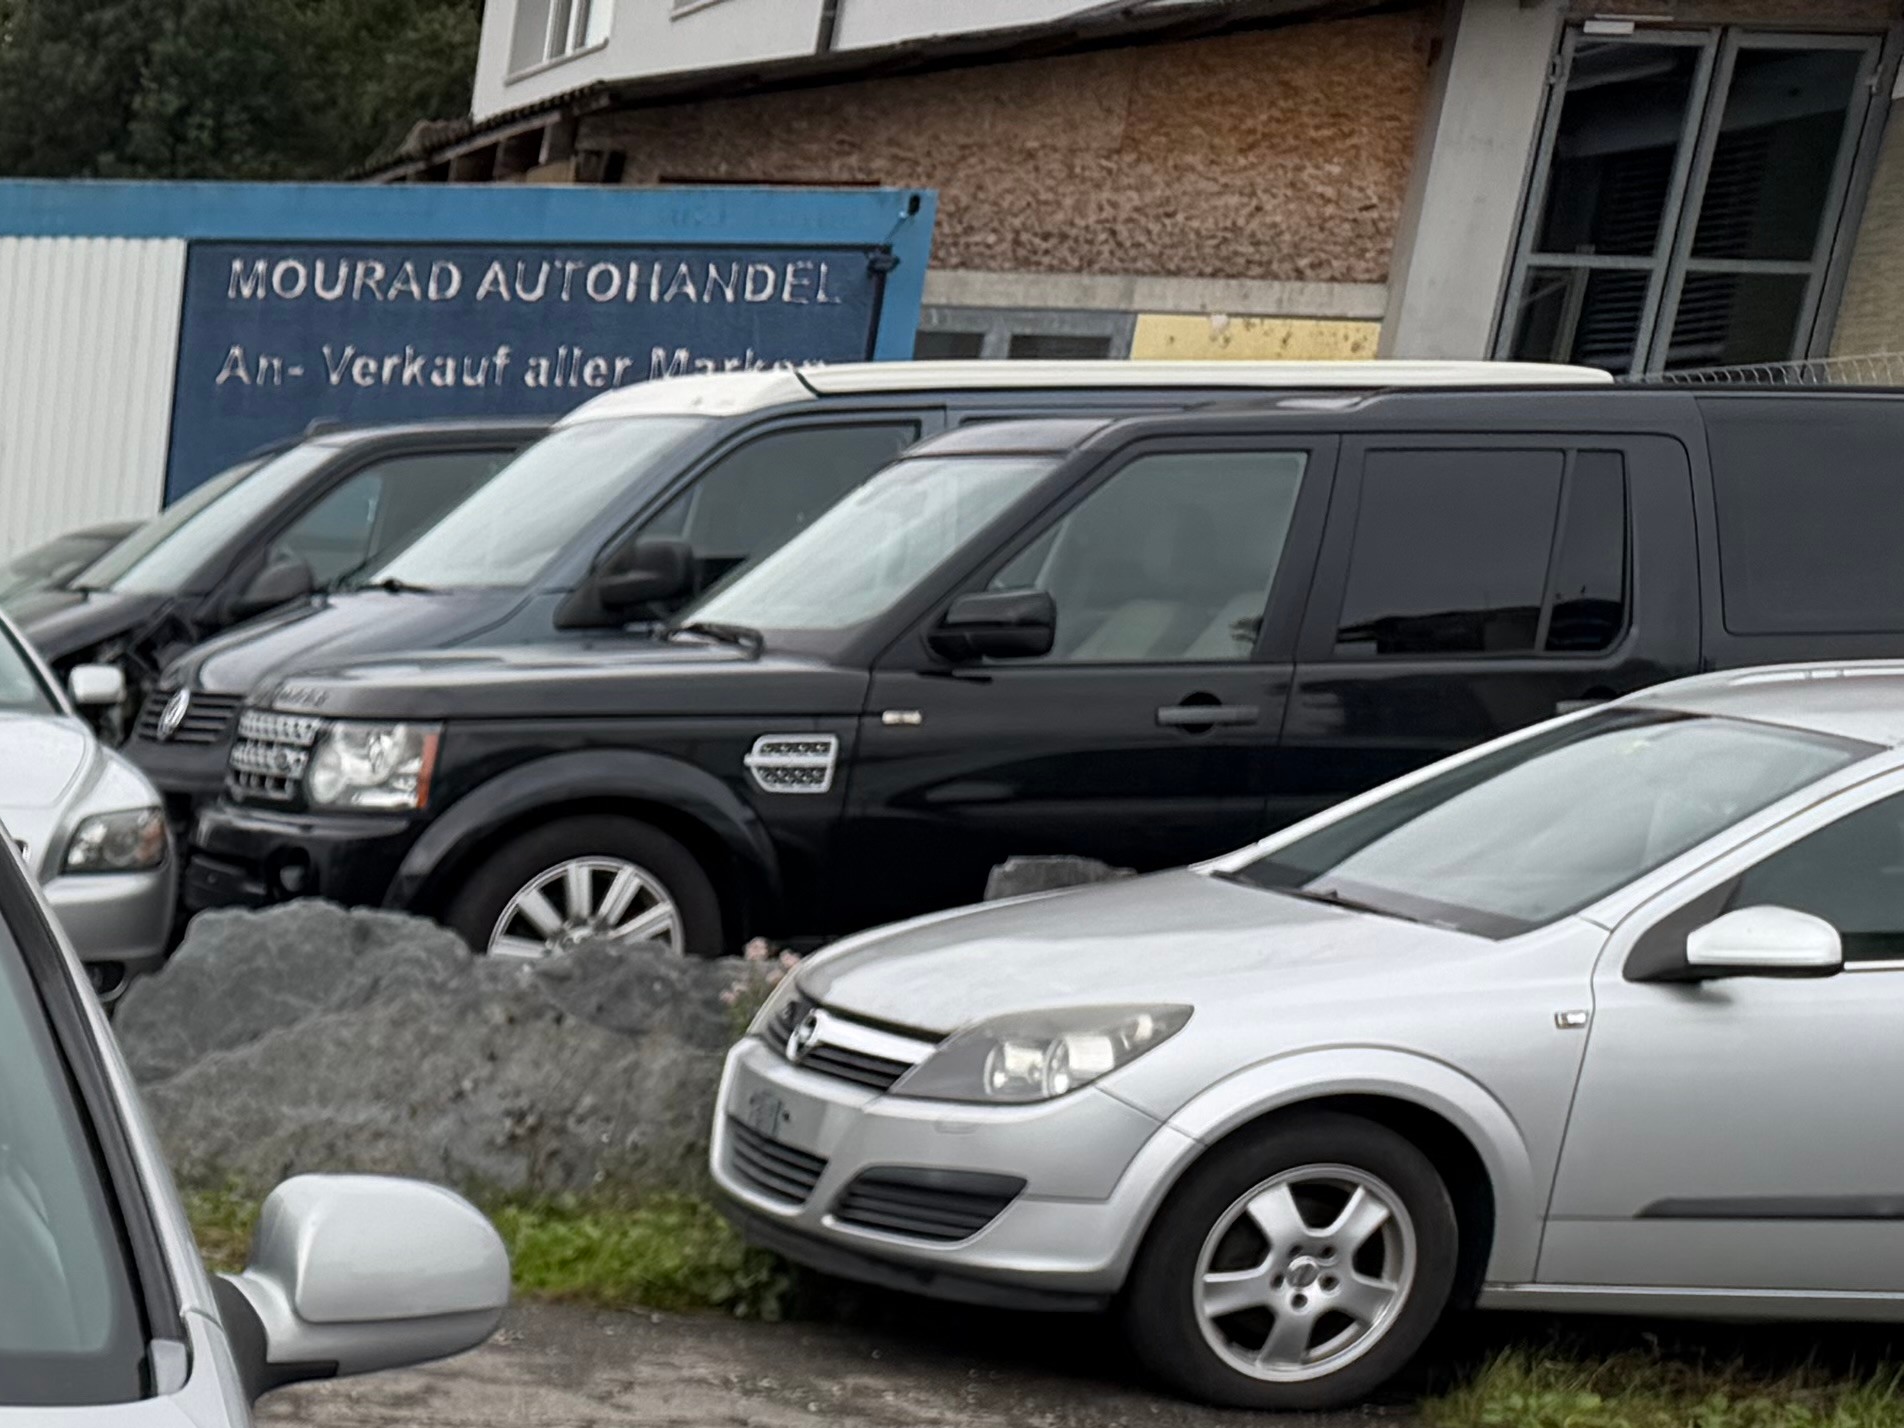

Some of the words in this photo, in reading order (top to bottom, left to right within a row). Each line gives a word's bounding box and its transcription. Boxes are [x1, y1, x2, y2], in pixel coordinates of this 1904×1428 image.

[228, 258, 462, 300] MOURAD
[476, 260, 841, 303] AUTOHANDEL
[215, 345, 304, 387] An-
[323, 345, 512, 388] Verkauf
[524, 345, 633, 388] aller
